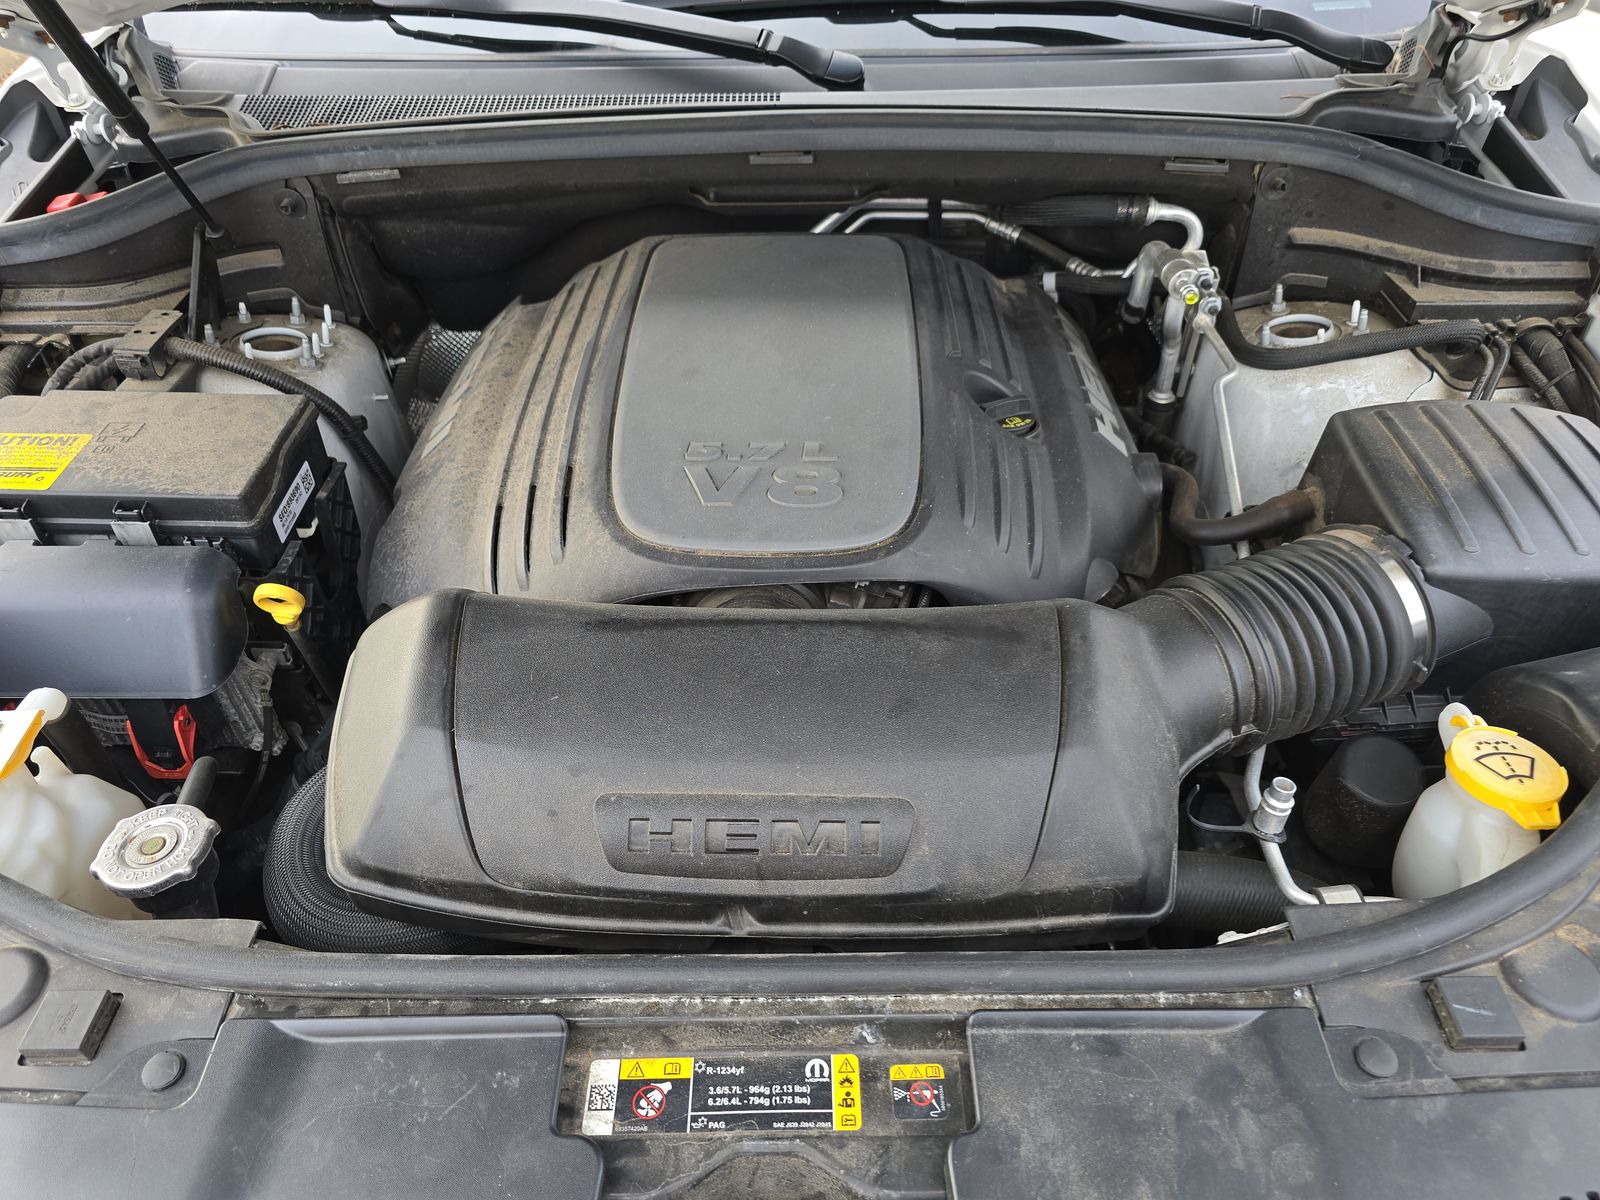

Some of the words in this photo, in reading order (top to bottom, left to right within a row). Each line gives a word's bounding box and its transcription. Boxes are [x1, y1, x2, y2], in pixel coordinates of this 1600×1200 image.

[684, 441, 787, 461] 5.7
[801, 441, 838, 461] L
[682, 465, 843, 508] V8
[130, 808, 167, 828] KEEP
[627, 817, 881, 856] HEMI
[124, 864, 164, 881] OPEN
[706, 1066, 745, 1076] R-1234yf
[708, 1086, 742, 1095] 3.6/5.7L
[748, 1086, 770, 1095] 964g
[772, 1085, 793, 1094] (2.13
[794, 1085, 811, 1094] lbs)
[708, 1097, 742, 1106] 6.2/6.4L
[748, 1097, 770, 1106] 794g
[772, 1096, 793, 1106] (1.75
[794, 1096, 811, 1105] lbs)
[708, 1121, 726, 1129] PAG
